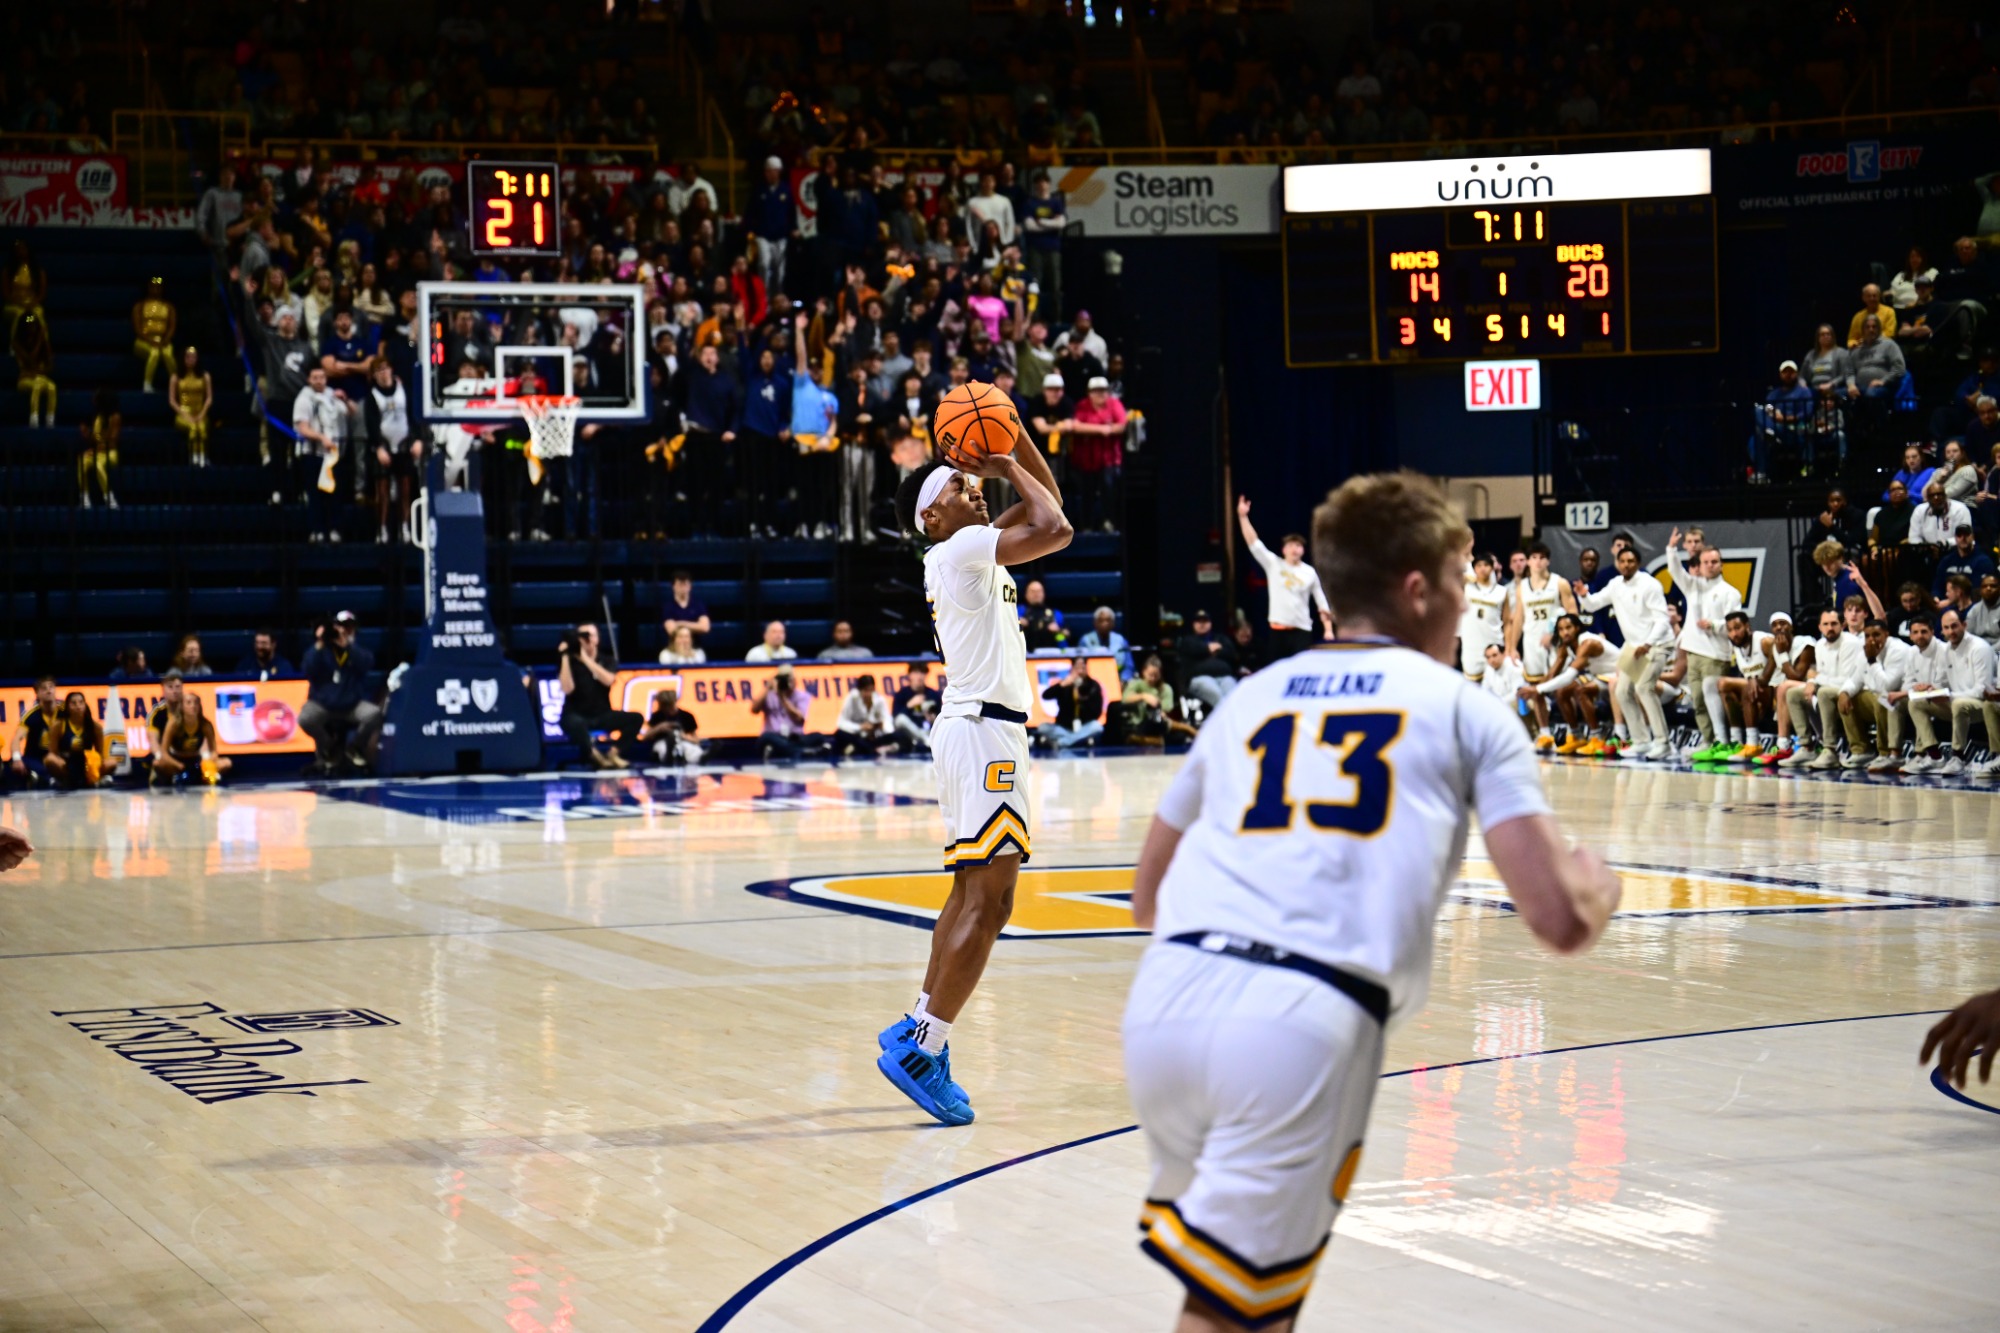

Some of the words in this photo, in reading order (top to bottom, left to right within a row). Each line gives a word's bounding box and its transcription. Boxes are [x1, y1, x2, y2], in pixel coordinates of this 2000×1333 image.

[1796, 152, 1847, 178] FOOD
[1881, 145, 1924, 170] CITY
[495, 170, 550, 197] 7:11
[1115, 171, 1213, 199] Steam
[1438, 168, 1553, 201] unum
[1739, 196, 1791, 211] OFFICIAL
[1794, 186, 1880, 207] SUPERMARKET
[486, 199, 544, 246] 21
[1115, 200, 1238, 234] Logistics
[1473, 210, 1544, 242] 7:11
[1390, 250, 1440, 271] MOCS
[1410, 271, 1440, 303] 14
[1498, 271, 1508, 297] 1
[1567, 263, 1610, 298] 20
[1399, 317, 1416, 345] 3
[1432, 317, 1451, 342] 4
[1485, 313, 1504, 342] 5
[1520, 314, 1530, 339] 1
[1547, 313, 1566, 338] 4
[1601, 311, 1610, 336] 1
[1470, 367, 1534, 406] EXIT
[1570, 504, 1605, 528] 112
[440, 585, 461, 599] for
[462, 585, 487, 599] the
[446, 571, 480, 586] Here
[432, 634, 463, 648] FOR
[464, 633, 495, 647] YOU
[444, 620, 485, 635] HERE
[695, 679, 754, 702] GEAR
[1283, 671, 1386, 699] HOLLAND
[421, 720, 439, 736] of
[440, 719, 516, 736] Tennessee
[983, 760, 1016, 793] C
[1236, 708, 1408, 841] 13
